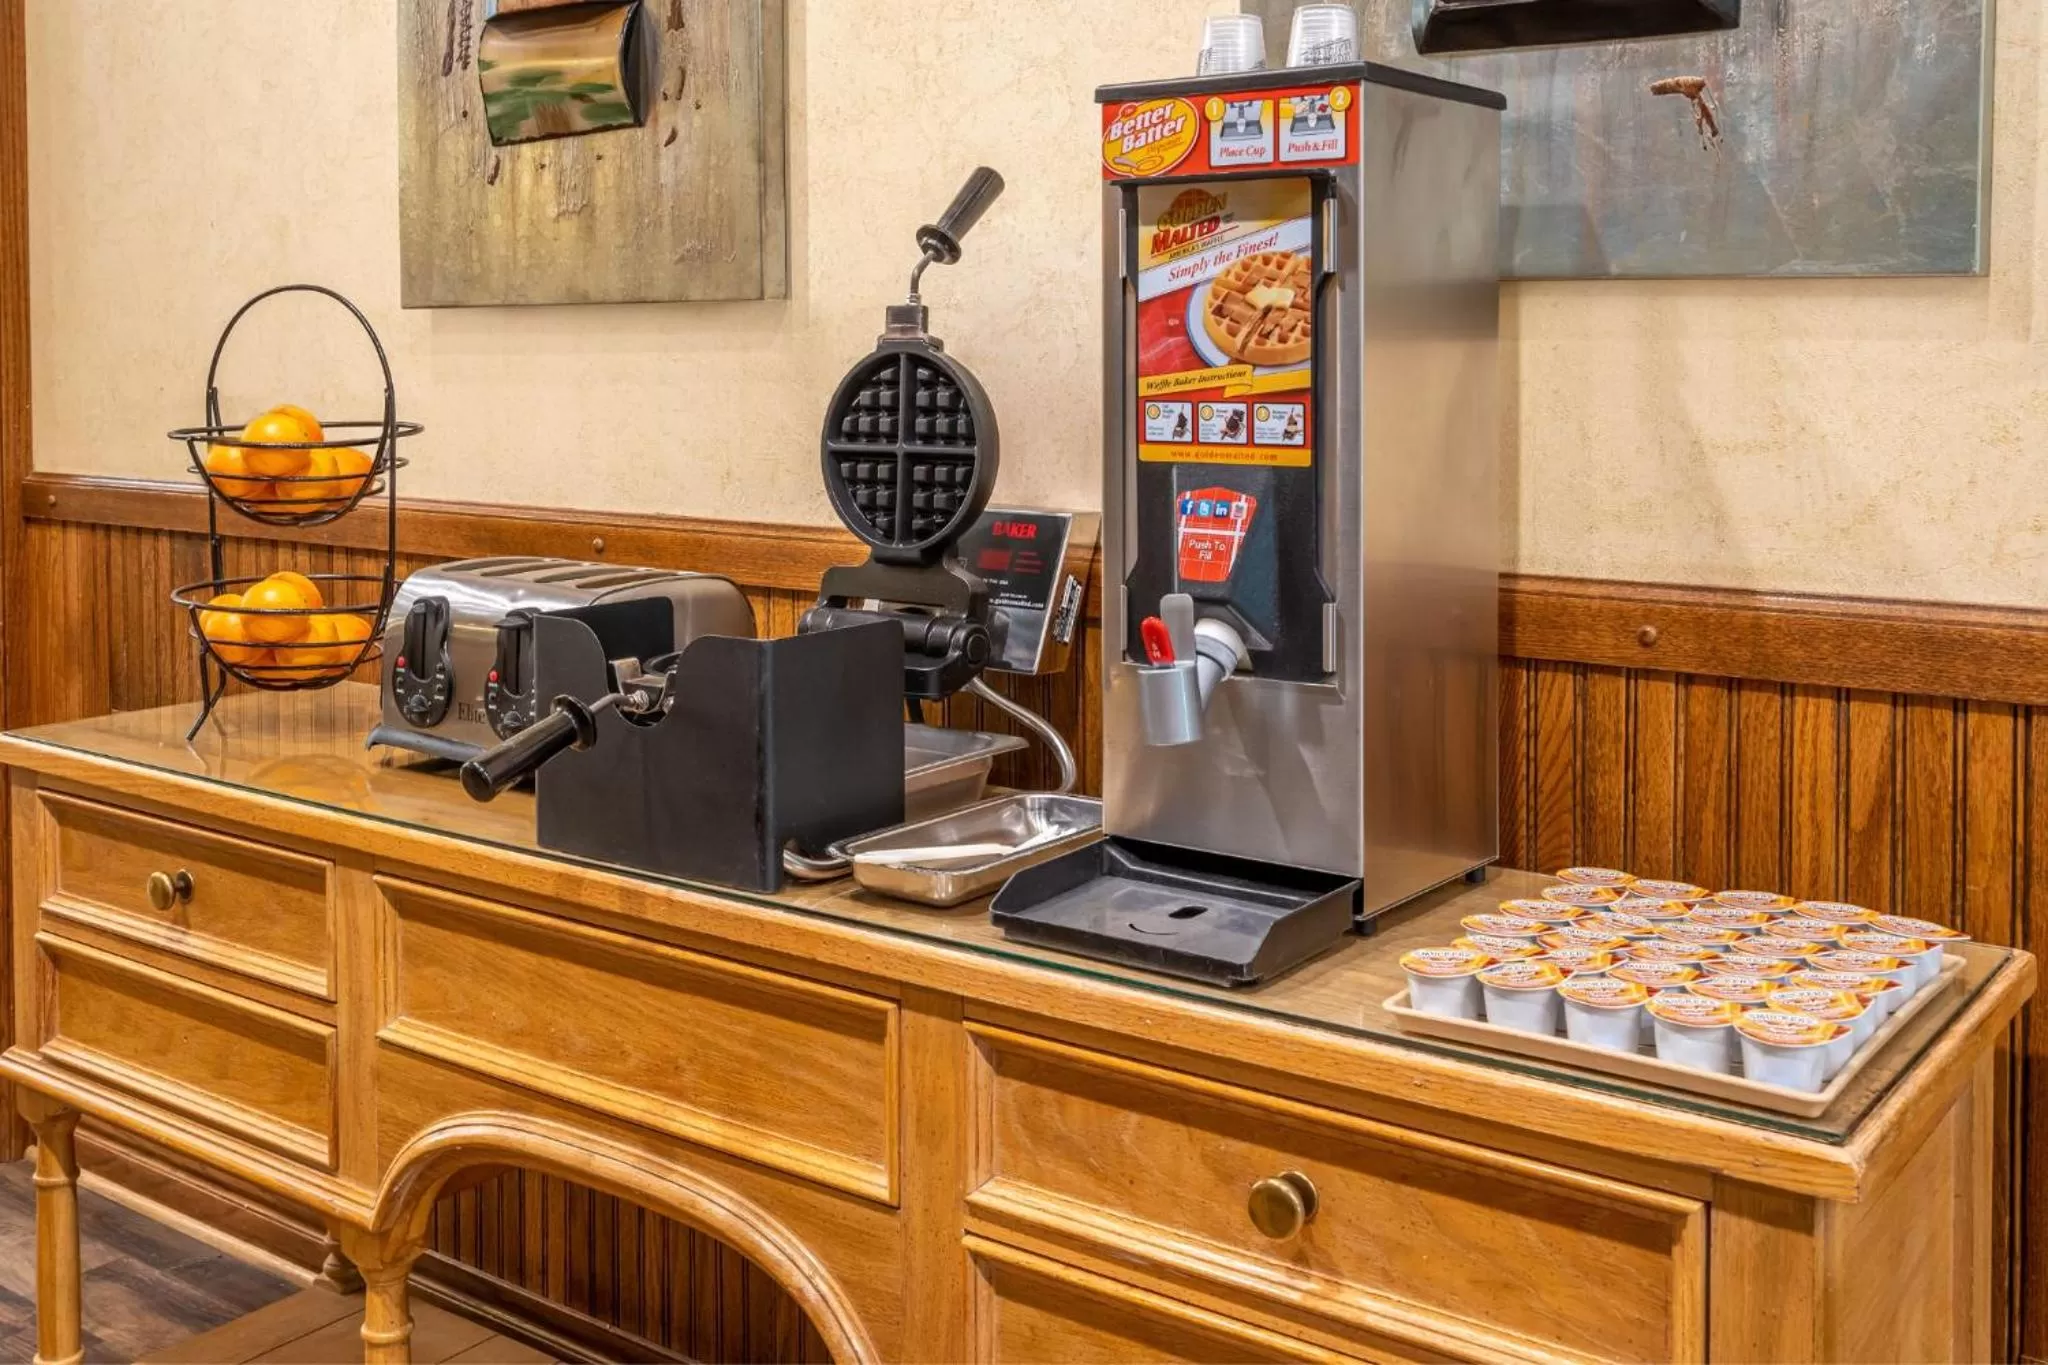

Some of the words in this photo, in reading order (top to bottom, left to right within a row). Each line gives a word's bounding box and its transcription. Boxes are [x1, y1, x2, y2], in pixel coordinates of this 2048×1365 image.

[1336, 92, 1346, 106] 2
[1109, 102, 1174, 141] Better
[1122, 114, 1187, 154] Batter
[1219, 146, 1244, 158] Place
[1246, 145, 1267, 158] Cup
[1288, 141, 1311, 153] Push
[1322, 139, 1339, 152] Fill
[1151, 215, 1221, 256] MALTED
[1168, 258, 1210, 282] Simply
[1213, 251, 1233, 267] the
[1235, 231, 1280, 259] Finest!
[1146, 377, 1173, 391] Waffle
[1173, 375, 1197, 388] Baker
[1198, 369, 1247, 384] Instructions
[992, 519, 1038, 539] BAKER
[1188, 538, 1212, 549] Push
[1214, 541, 1226, 551] To
[458, 701, 487, 725] Elite
